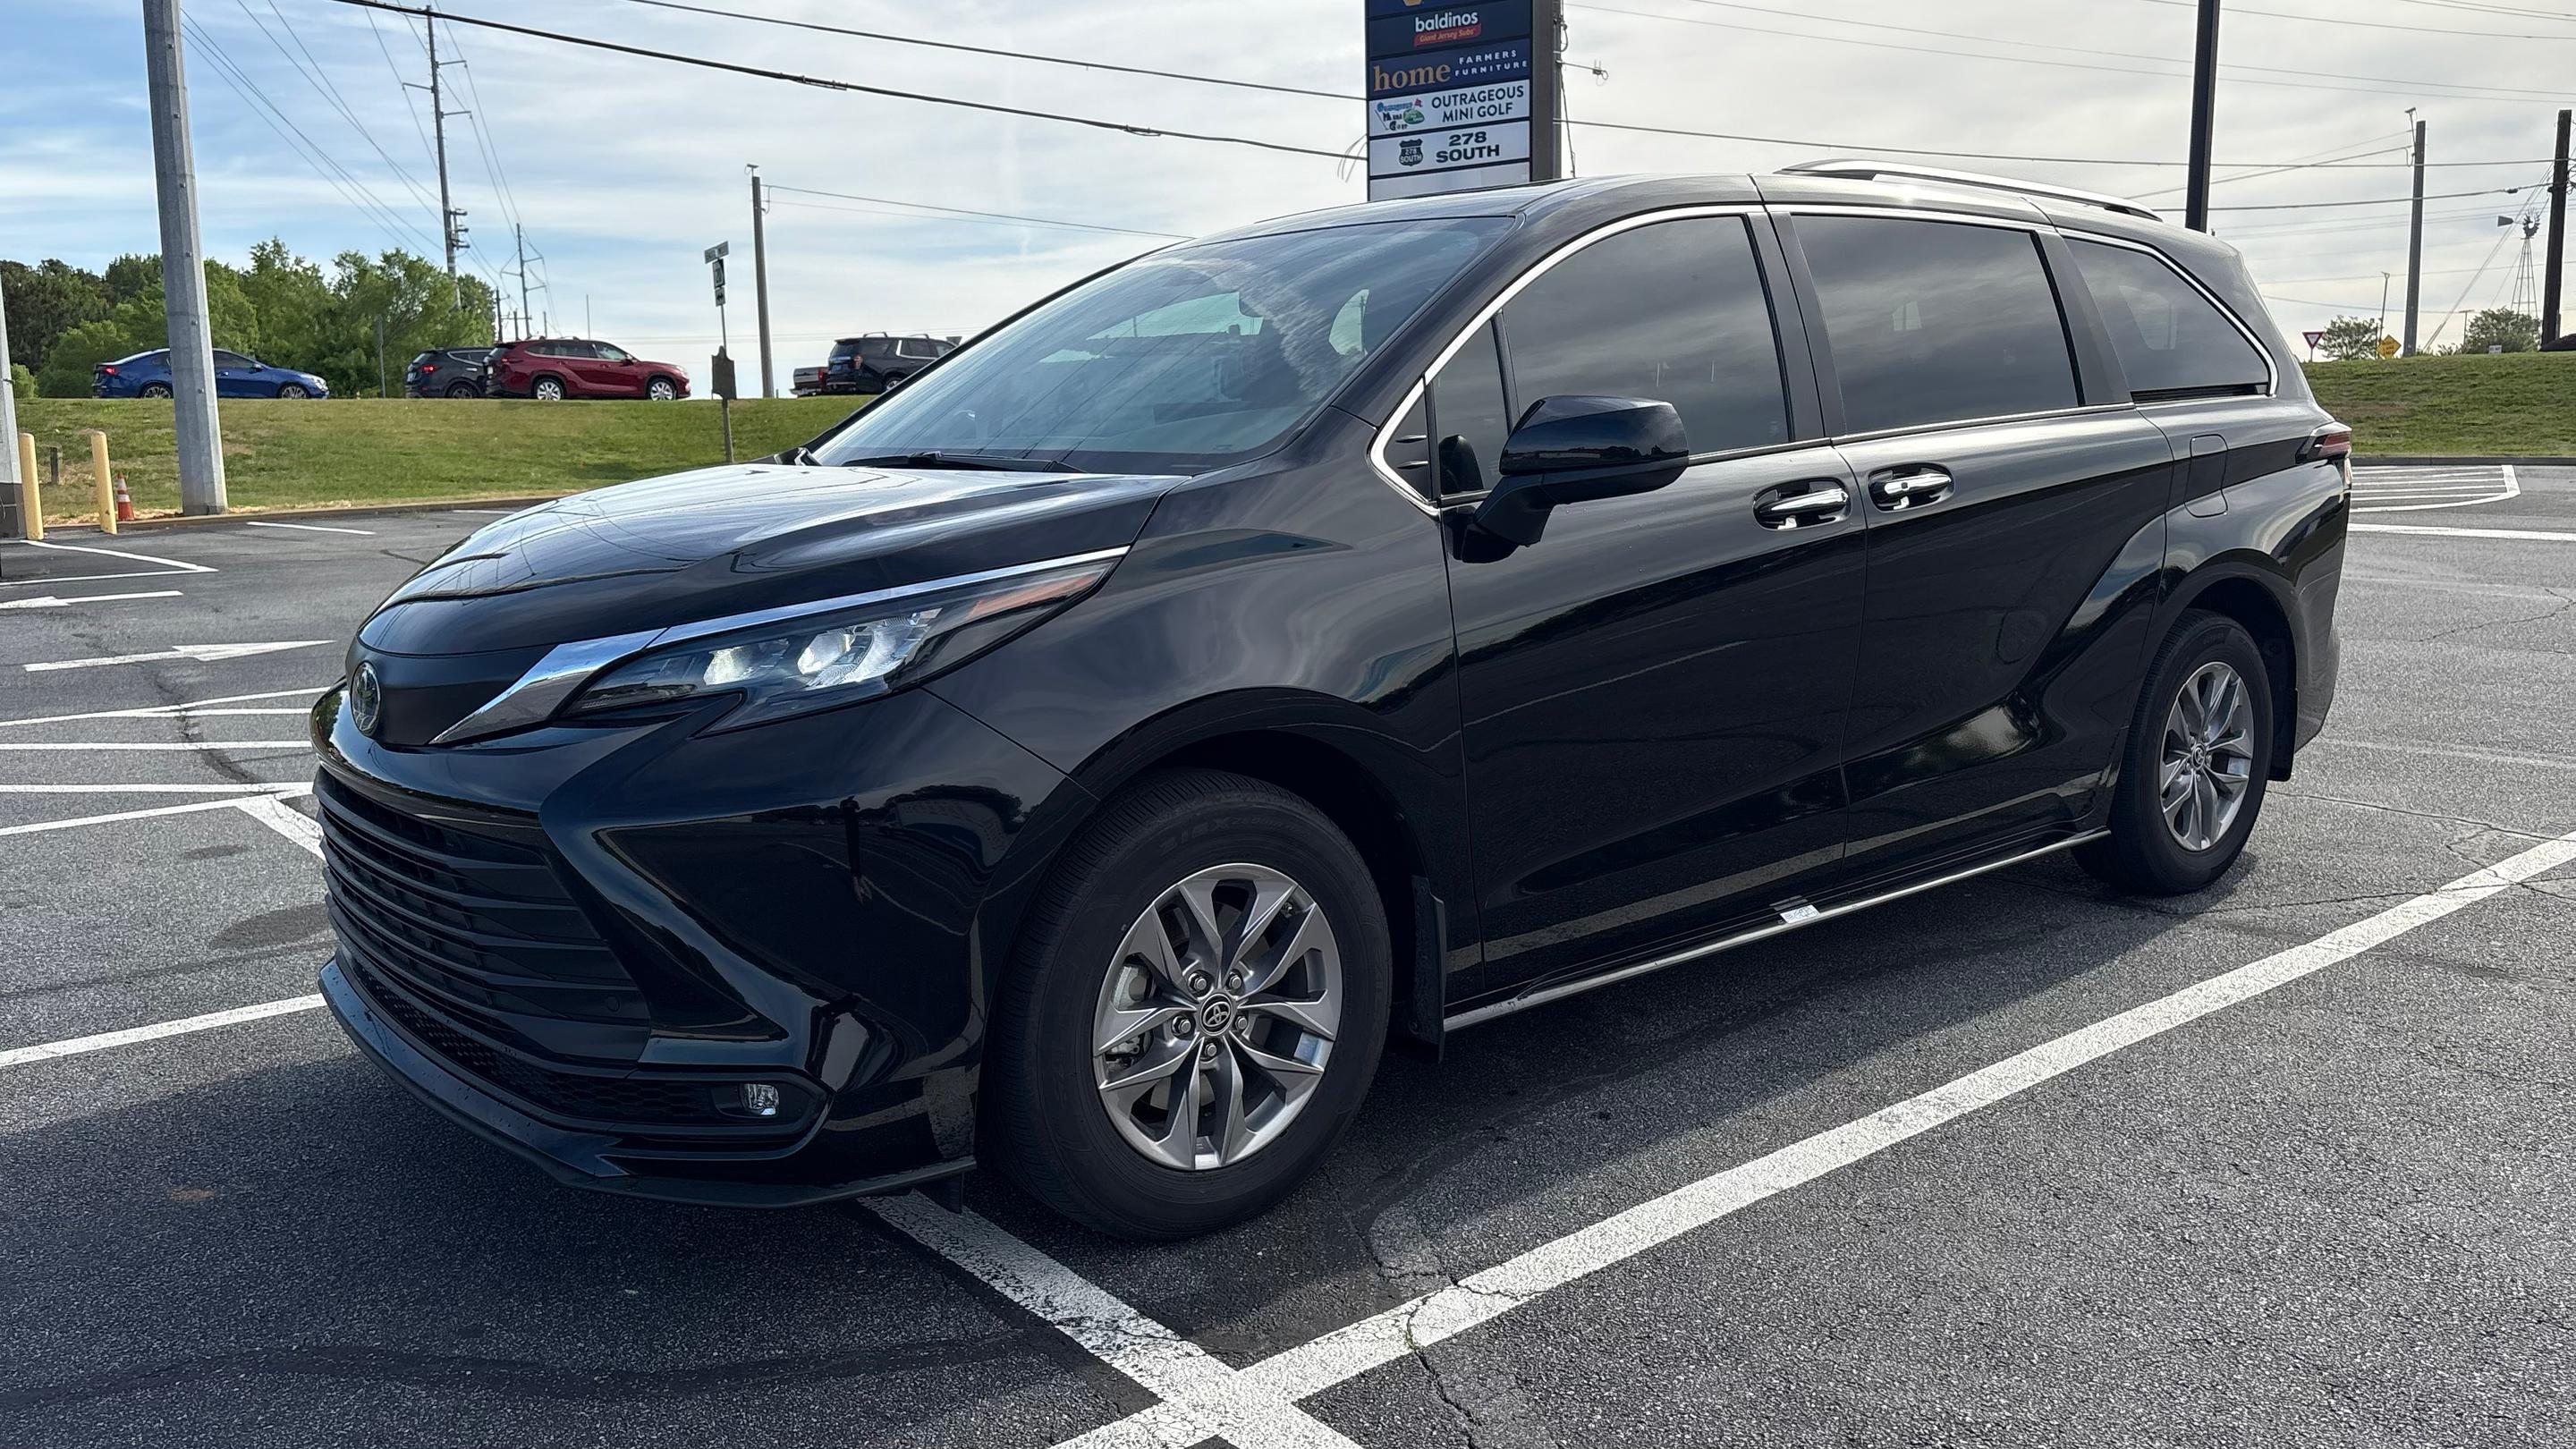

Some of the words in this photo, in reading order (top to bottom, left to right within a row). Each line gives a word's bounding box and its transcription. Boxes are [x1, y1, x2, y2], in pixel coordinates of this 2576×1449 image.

[1415, 11, 1479, 32] baldinos
[1459, 49, 1517, 64] FARMERS
[1373, 64, 1451, 91] home
[1454, 60, 1528, 77] FURNITURE
[1431, 85, 1524, 108] OUTRAGEOUS
[1442, 108, 1473, 123] MINI
[1477, 102, 1513, 118] GOLF
[1449, 131, 1487, 147] 278
[1400, 154, 1422, 164] SOUTH
[1436, 144, 1500, 163] SOUTH
